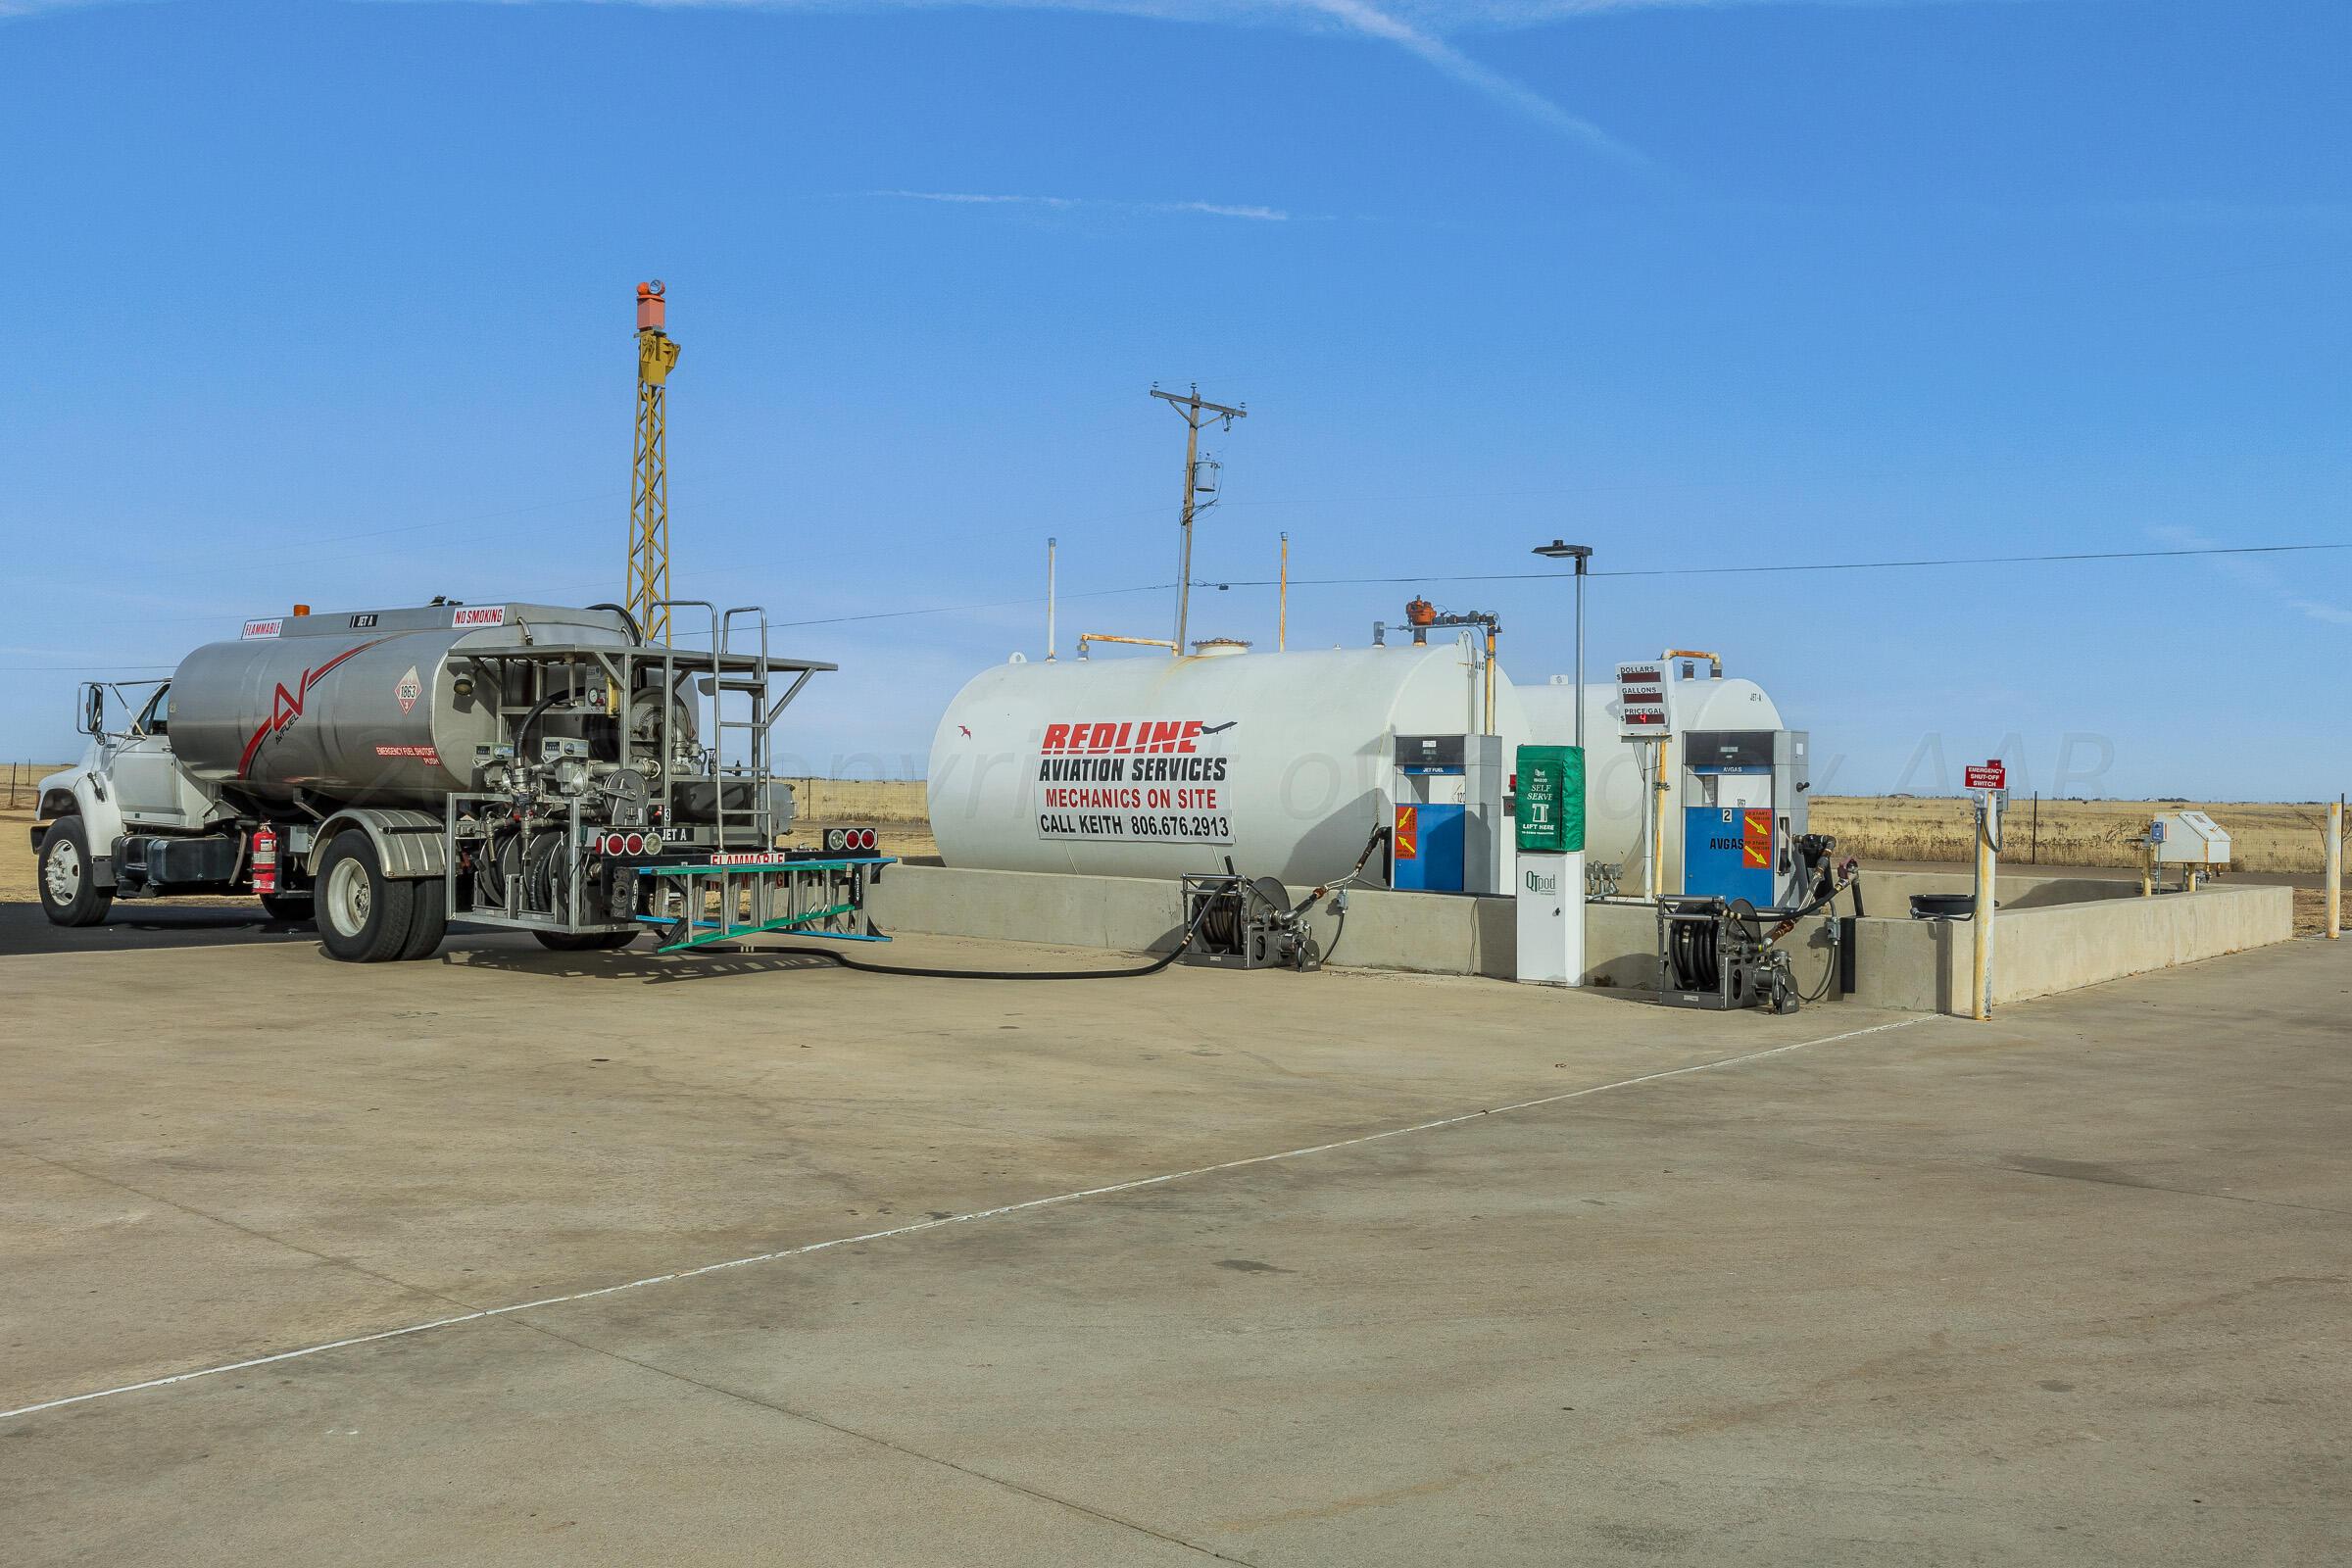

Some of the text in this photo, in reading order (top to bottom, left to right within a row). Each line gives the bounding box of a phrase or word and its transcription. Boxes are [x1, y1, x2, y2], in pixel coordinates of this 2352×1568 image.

[455, 609, 503, 624] NO SMOKING
[245, 620, 280, 636] FLAMMABLE
[401, 685, 416, 698] 1863
[1640, 714, 1646, 724] 4
[275, 714, 300, 745] AVFUEL
[1041, 720, 1203, 755] REDLINE
[376, 747, 403, 756] EMERGENCY
[403, 747, 416, 756] FUEL
[1039, 757, 1228, 782] AVIATION SERVICES
[1046, 788, 1217, 809] MECHANICS ON SITE
[1527, 792, 1553, 801] SERVE
[666, 808, 670, 821] 3
[1724, 809, 1731, 821] 2
[1040, 813, 1229, 837] CALL KEITH 806.676.2913
[662, 828, 687, 841] JET A
[1709, 838, 1744, 850] AVGAS
[712, 853, 784, 865] FLAMMABLE
[1526, 870, 1555, 893] QTpod
